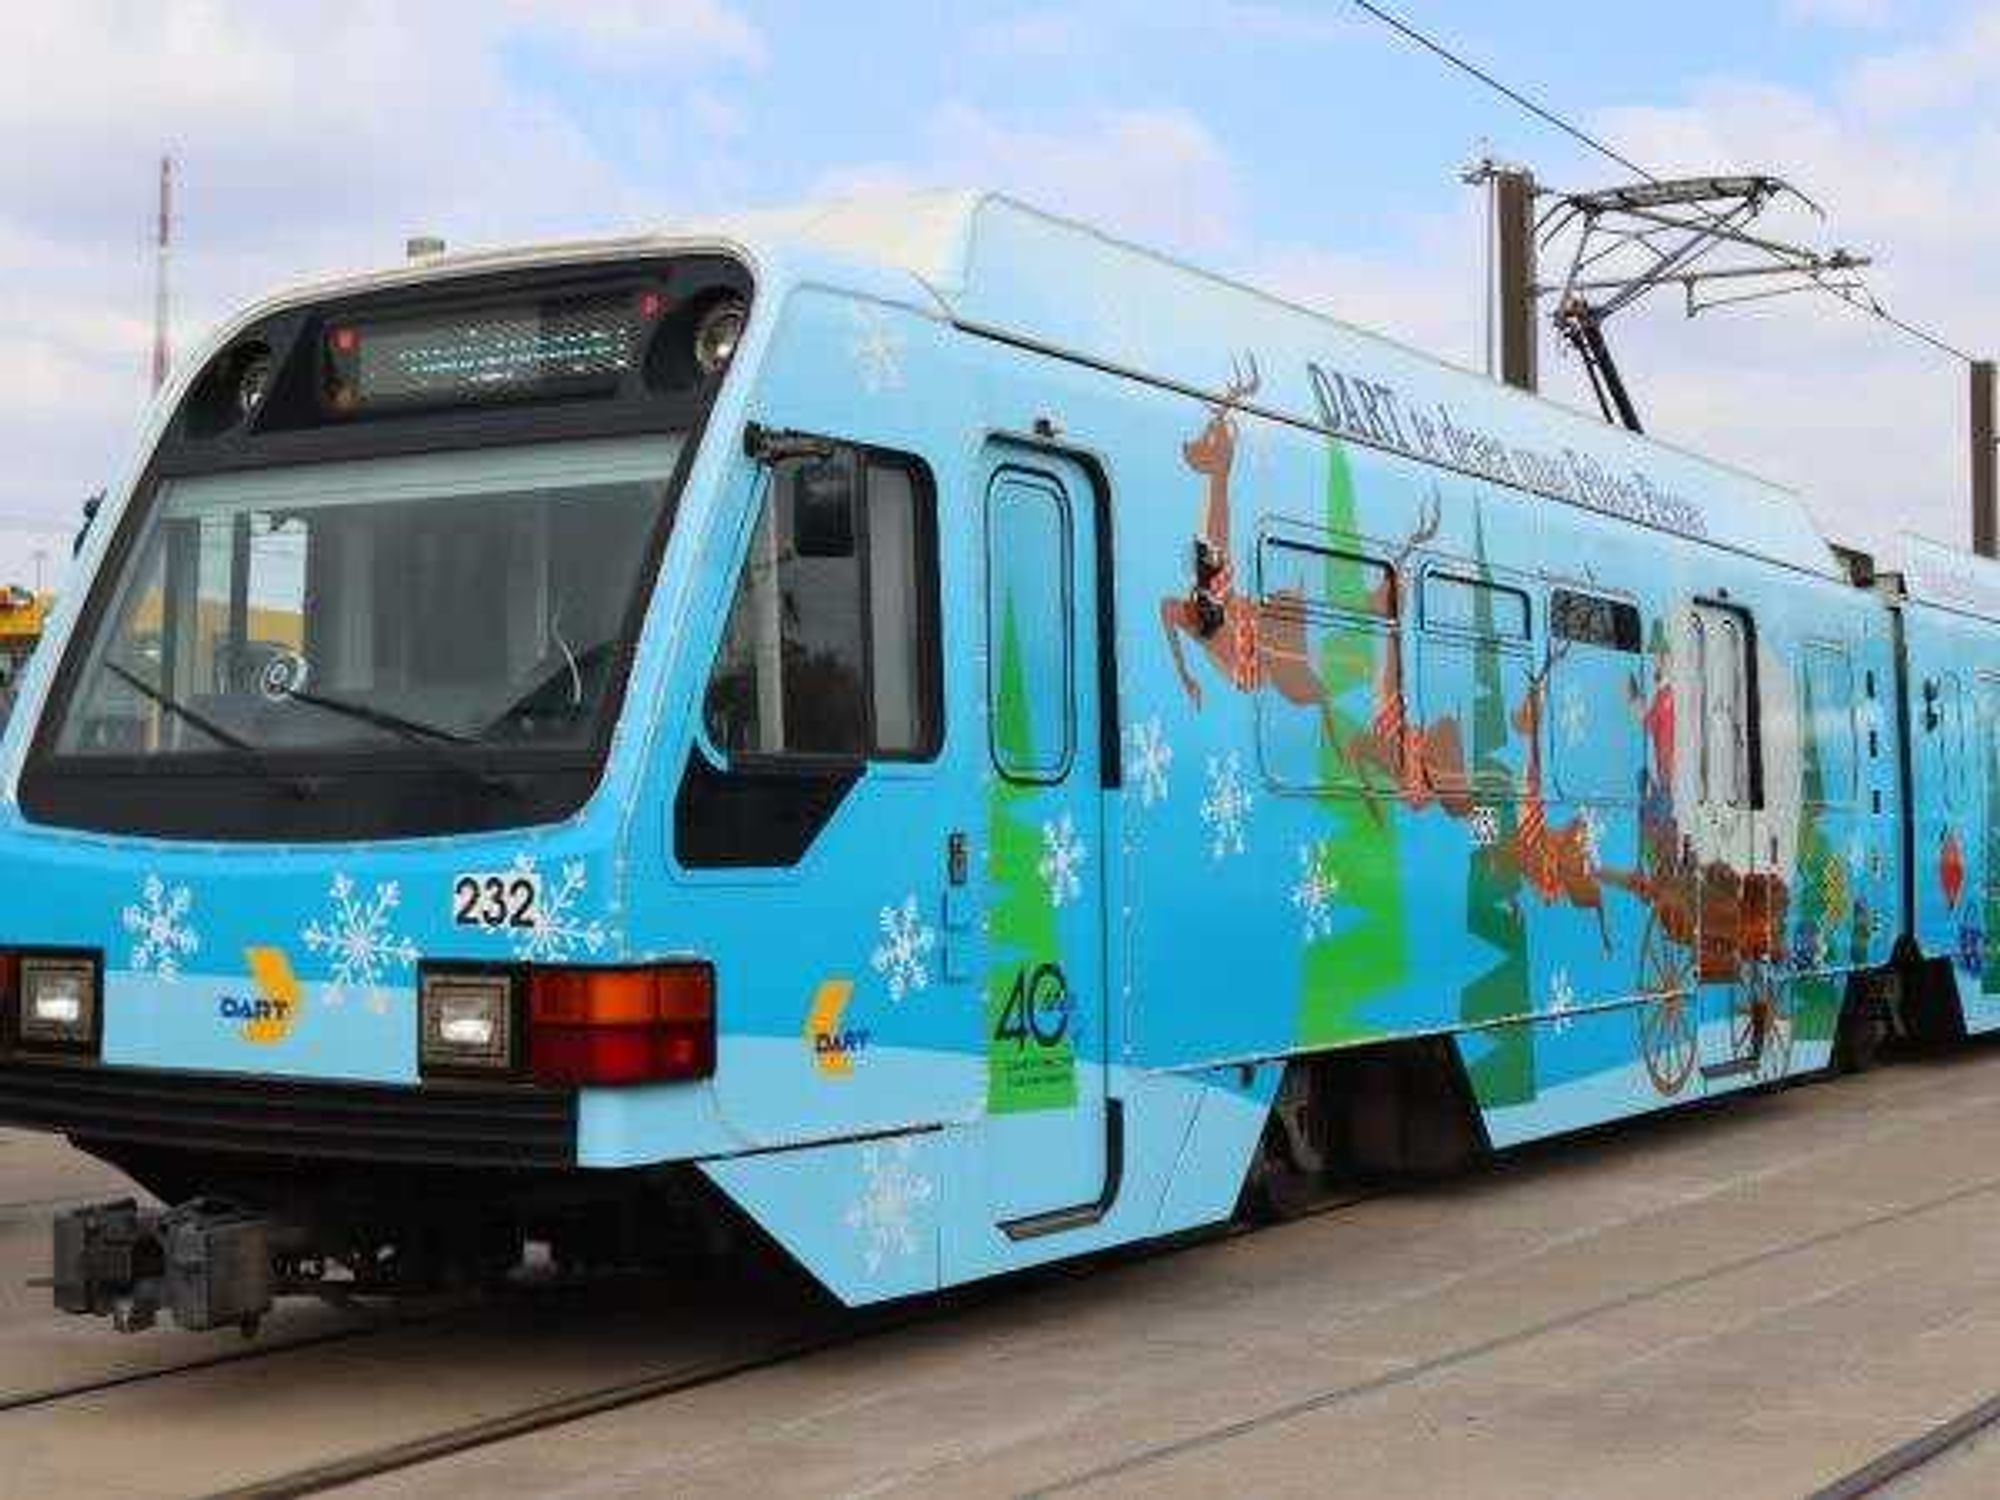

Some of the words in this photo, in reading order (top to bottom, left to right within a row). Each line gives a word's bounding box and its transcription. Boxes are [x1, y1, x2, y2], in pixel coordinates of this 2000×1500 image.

[1306, 361, 1411, 454] DART
[455, 876, 536, 929] 232
[219, 996, 290, 1020] DART
[994, 963, 1069, 1052] 40
[815, 1029, 872, 1053] DART
